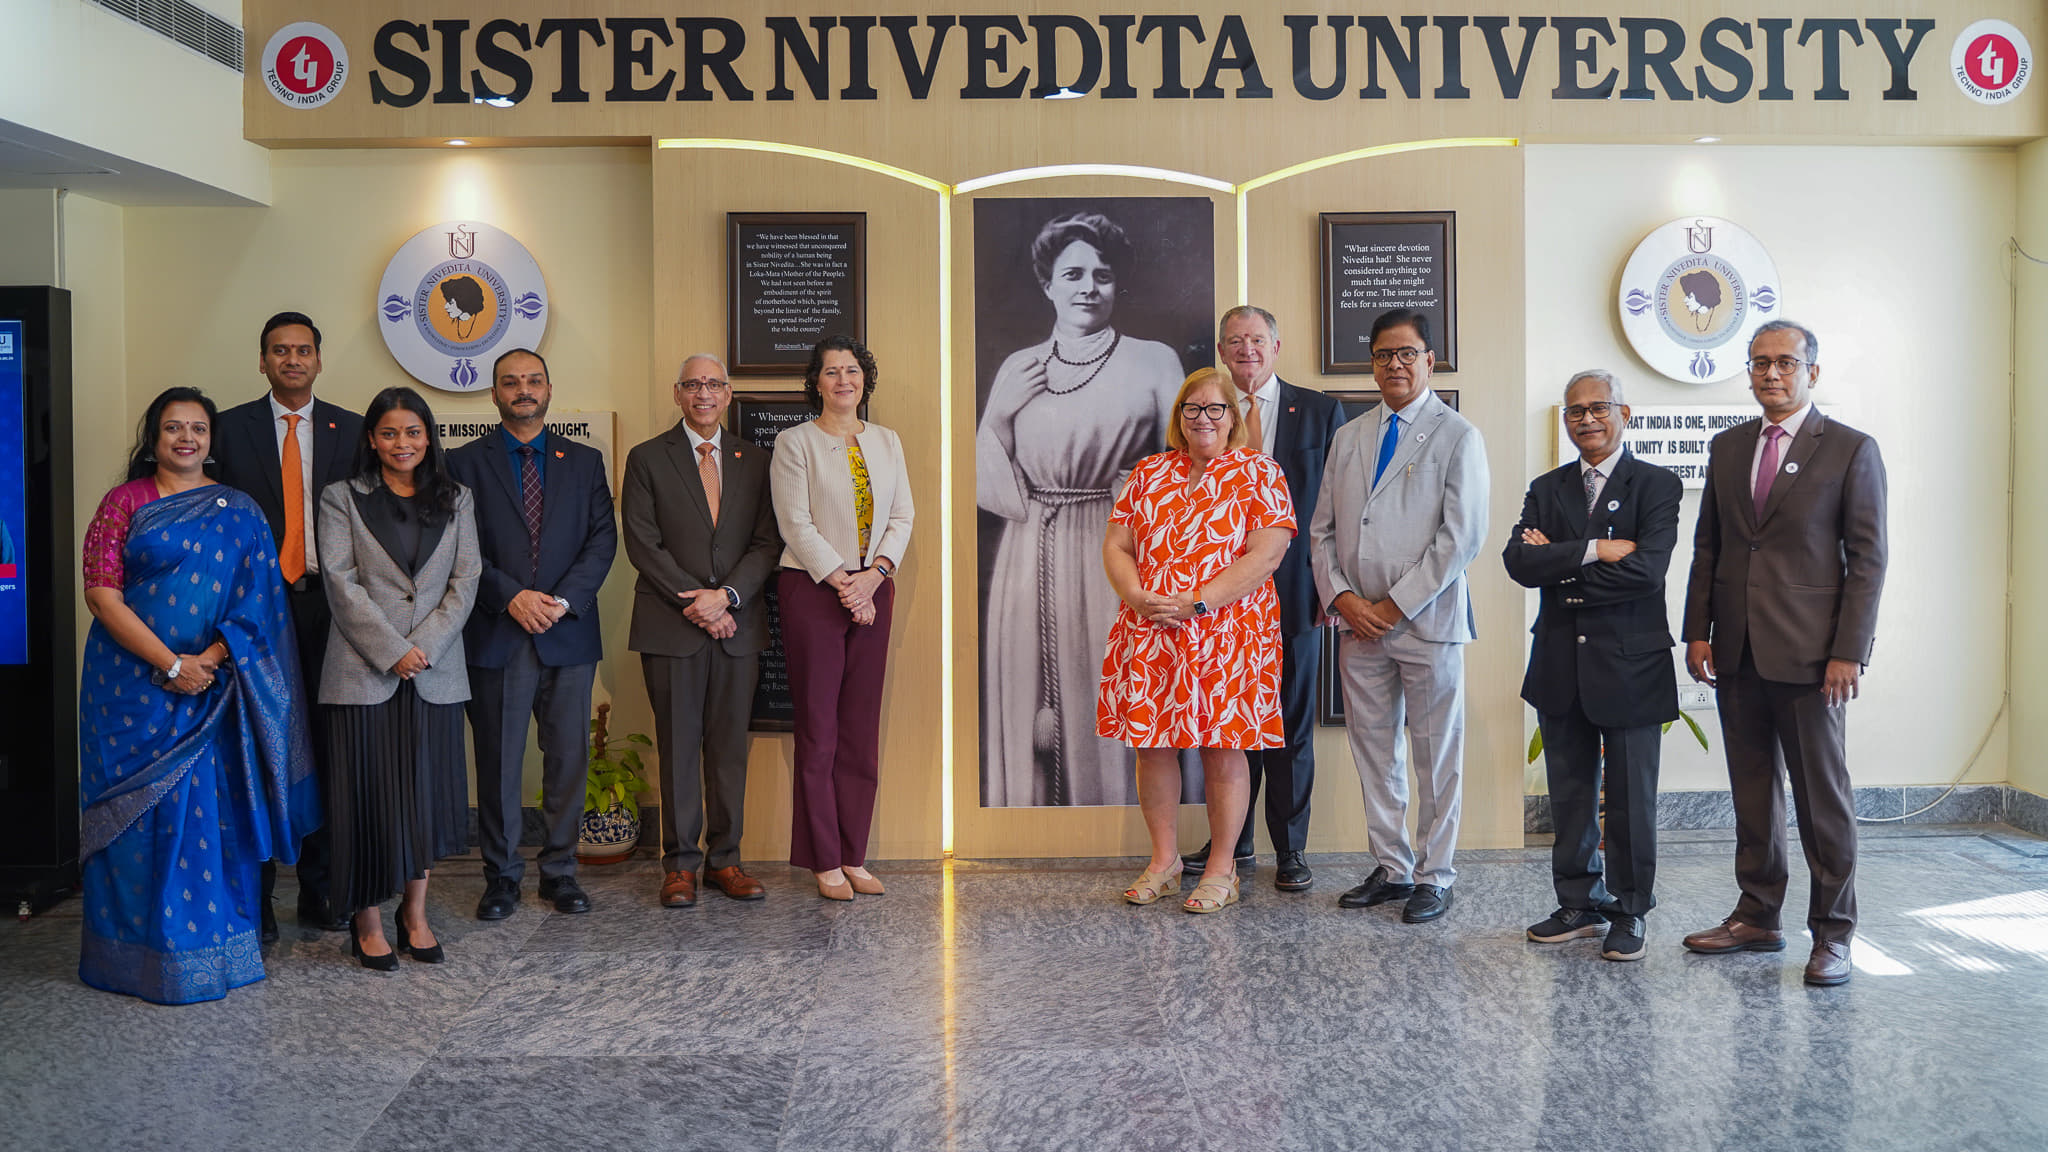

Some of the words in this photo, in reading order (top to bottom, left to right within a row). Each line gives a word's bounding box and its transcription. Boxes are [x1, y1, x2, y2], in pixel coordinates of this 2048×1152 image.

[369, 17, 753, 108] SISTER
[765, 14, 1273, 101] NIVEDITA
[1284, 15, 1935, 104] UNIVERSITY
[267, 66, 294, 101] TECHNO
[298, 92, 326, 104] INDIA
[326, 61, 344, 94] GROUP
[1956, 65, 1983, 97] TECHNO
[1985, 88, 2012, 100] INDIA
[2012, 57, 2028, 89] GROUP
[1370, 244, 1396, 252] sincere
[1342, 256, 1374, 264] Nivedita
[1375, 255, 1392, 263] had!
[1396, 255, 1410, 263] She
[781, 270, 804, 278] (Mother
[805, 270, 812, 278] of
[812, 270, 822, 278] the
[1344, 267, 1383, 275] considered
[1385, 266, 1417, 275] anything
[1351, 278, 1372, 286] much
[1403, 277, 1425, 286] might
[418, 289, 430, 322] SISTER
[426, 263, 471, 287] NIVEDITA
[476, 267, 508, 321] UNIVERSITY
[1342, 289, 1352, 297] do
[1353, 289, 1364, 297] for
[1397, 288, 1416, 296] inner
[1418, 288, 1434, 296] soul
[1659, 283, 1670, 317] SISTER
[1666, 258, 1709, 281] NIVEDITA
[1714, 261, 1743, 314] UNIVERSITY
[1340, 300, 1358, 308] feels
[1360, 300, 1370, 308] for
[1378, 299, 1405, 307] sincere
[759, 412, 804, 421] Whenever
[804, 412, 819, 421] she
[1626, 416, 1644, 429] HAT
[1647, 416, 1671, 429] INDIA
[1674, 416, 1682, 429] IS
[1685, 416, 1706, 432] ONE,
[449, 424, 499, 437] MISSION
[754, 425, 779, 436] speak
[755, 439, 761, 447] it
[1636, 440, 1663, 454] UNITY
[1668, 440, 1677, 454] IS
[1680, 440, 1704, 454] BUILT
